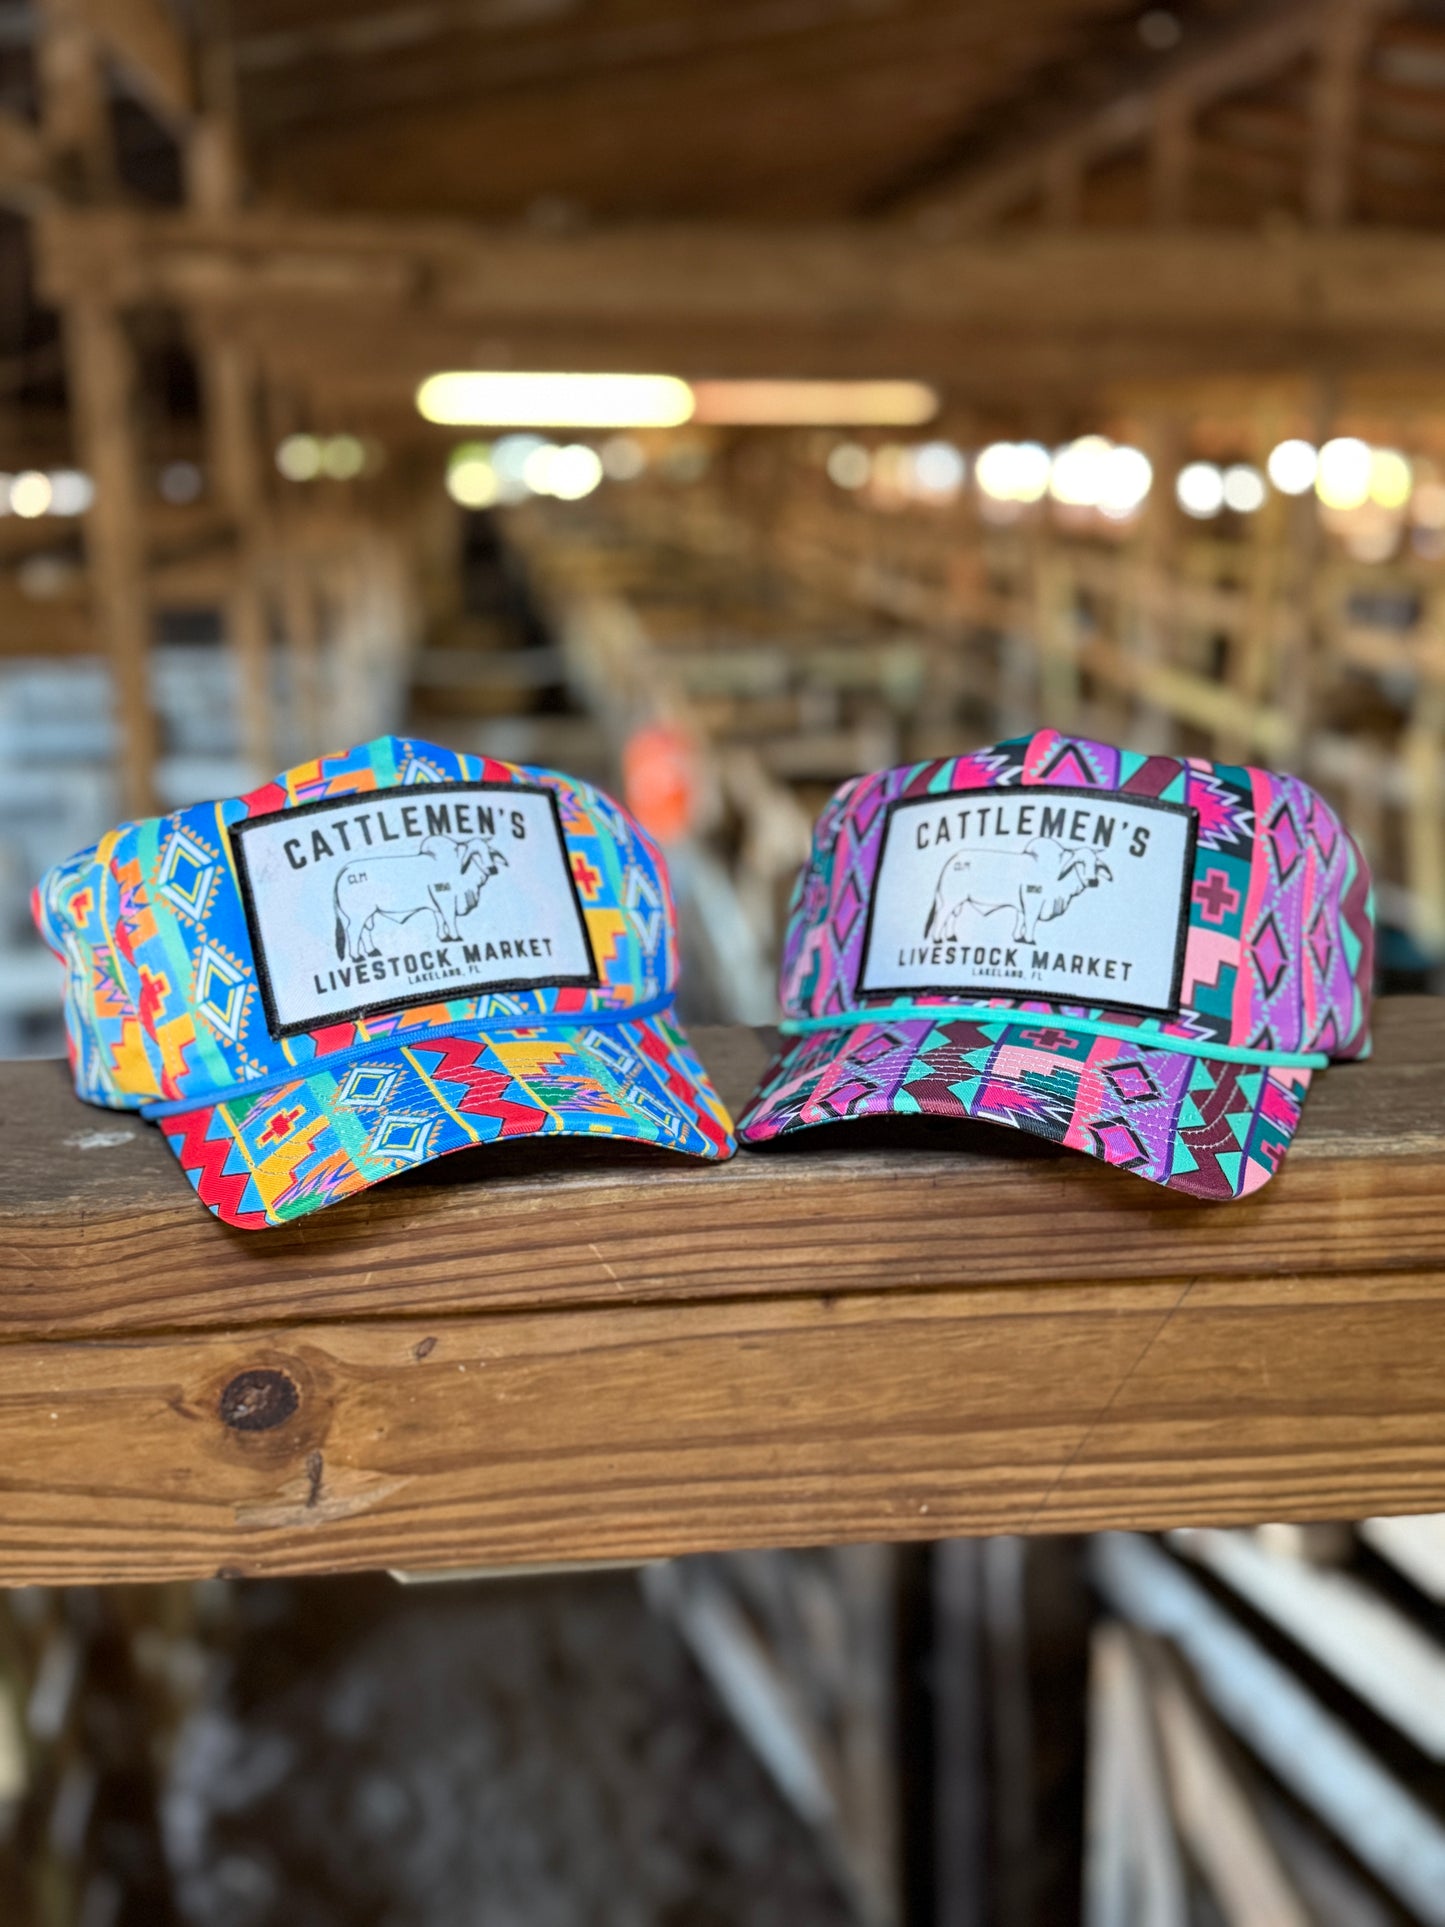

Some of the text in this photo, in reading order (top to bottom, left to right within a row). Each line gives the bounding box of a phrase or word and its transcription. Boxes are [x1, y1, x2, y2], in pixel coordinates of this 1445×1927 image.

[283, 803, 527, 870] CATTLEMEN'S
[916, 805, 1150, 858] CATTLEMEN'S
[314, 938, 553, 994] LIVESTOCK MARKET
[468, 964, 481, 974] FL
[898, 945, 1133, 981] LIVESTOCK MARKET
